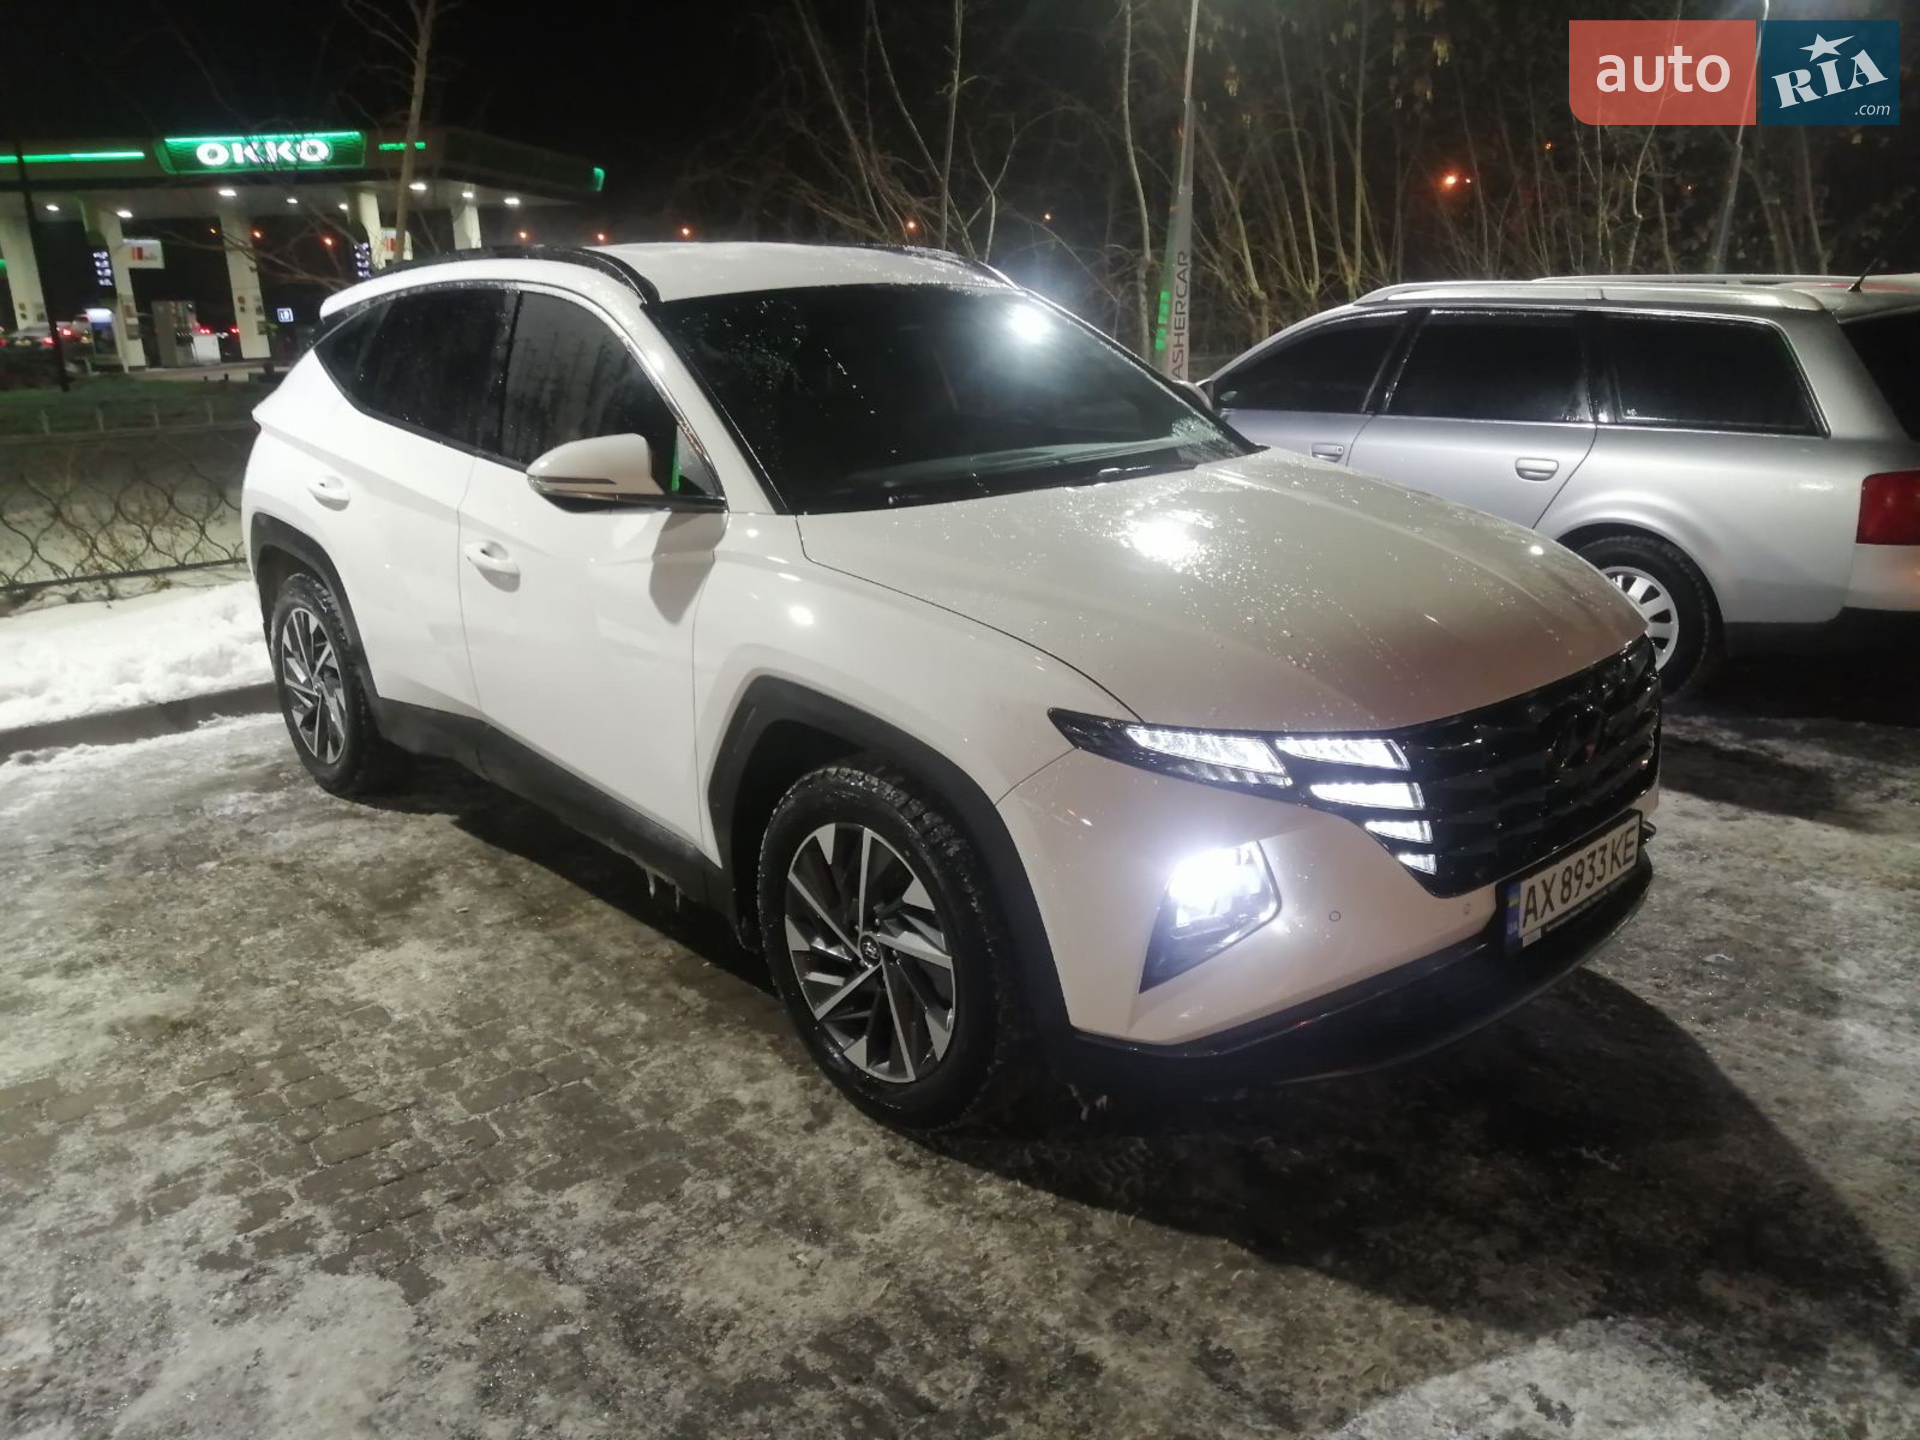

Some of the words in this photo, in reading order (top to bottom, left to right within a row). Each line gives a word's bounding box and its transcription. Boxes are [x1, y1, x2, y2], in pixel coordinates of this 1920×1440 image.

[196, 139, 330, 167] OKKO
[1522, 873, 1557, 928] AX
[1560, 843, 1608, 905] 8933
[1610, 825, 1638, 875] KE
